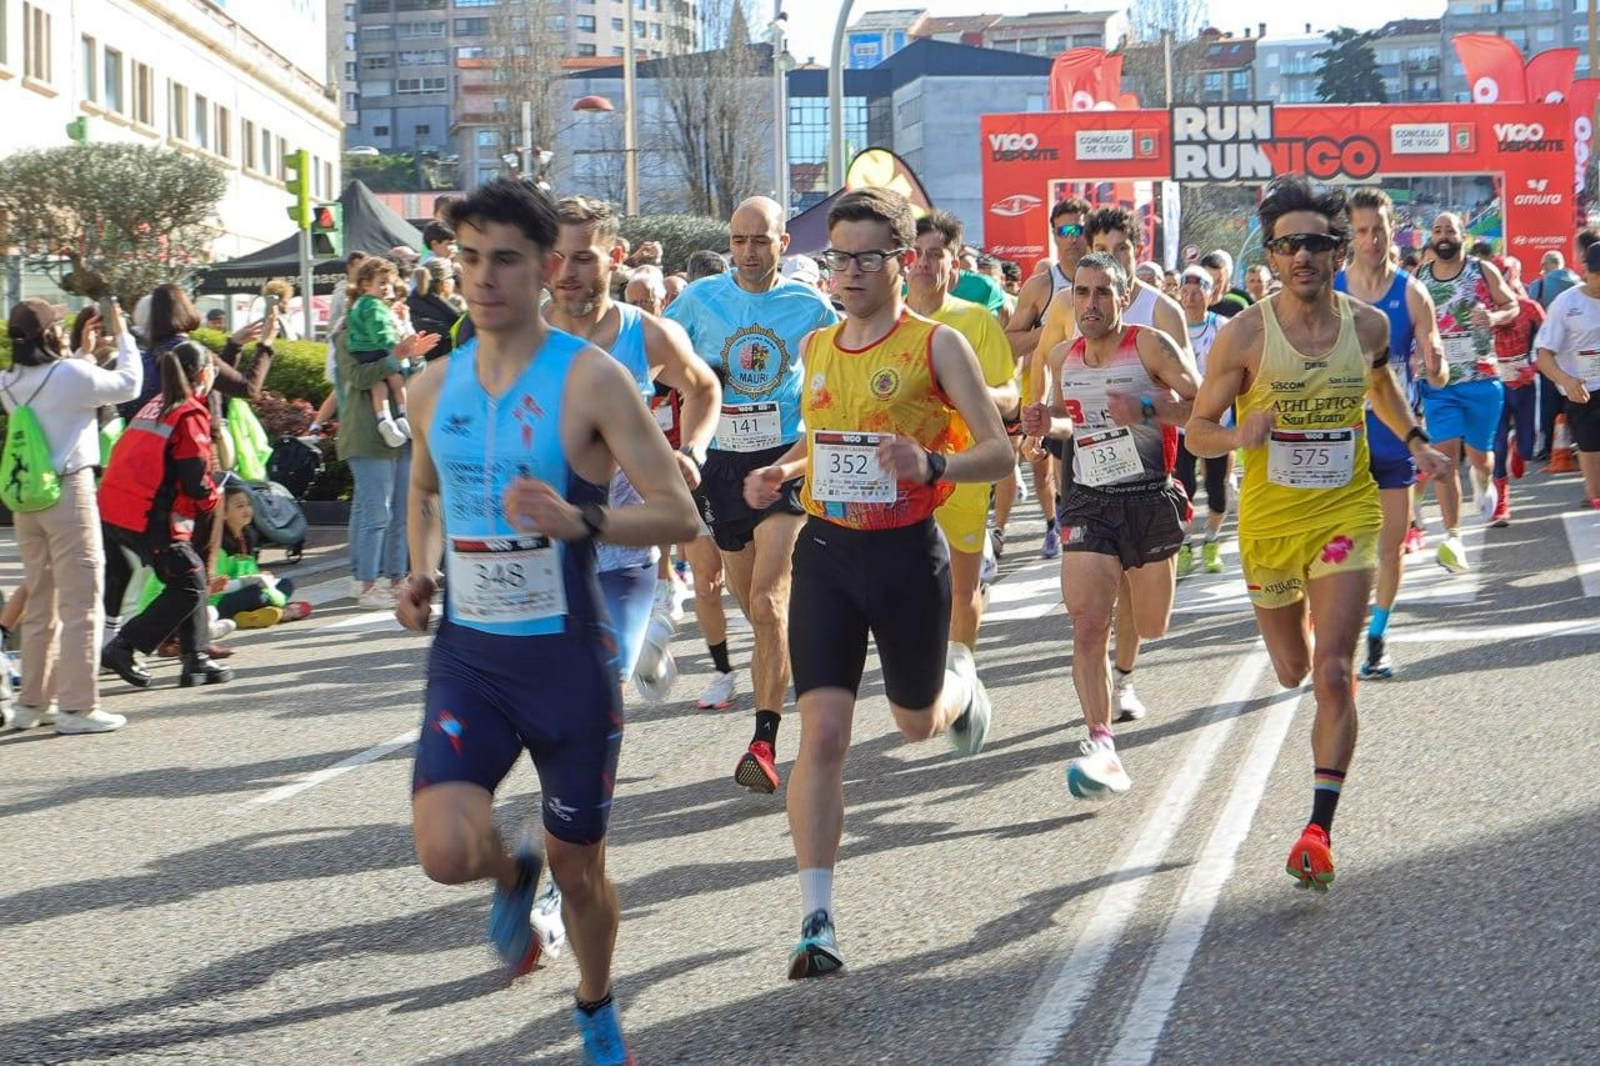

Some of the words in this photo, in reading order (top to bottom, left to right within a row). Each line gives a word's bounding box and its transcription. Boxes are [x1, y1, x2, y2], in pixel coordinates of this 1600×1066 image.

[1173, 105, 1271, 141] RUN
[1492, 123, 1545, 142] VIGO
[988, 133, 1039, 151] VIGO
[1497, 140, 1565, 152] DEPORTE
[992, 148, 1060, 162] DEPORTE
[1513, 193, 1562, 206] amura
[1271, 396, 1359, 413] ATHLETICS
[731, 418, 758, 434] 141
[1281, 413, 1304, 426] San
[829, 453, 868, 475] 352
[1091, 446, 1117, 465] 133
[1291, 448, 1330, 466] 575
[473, 562, 527, 590] 348
